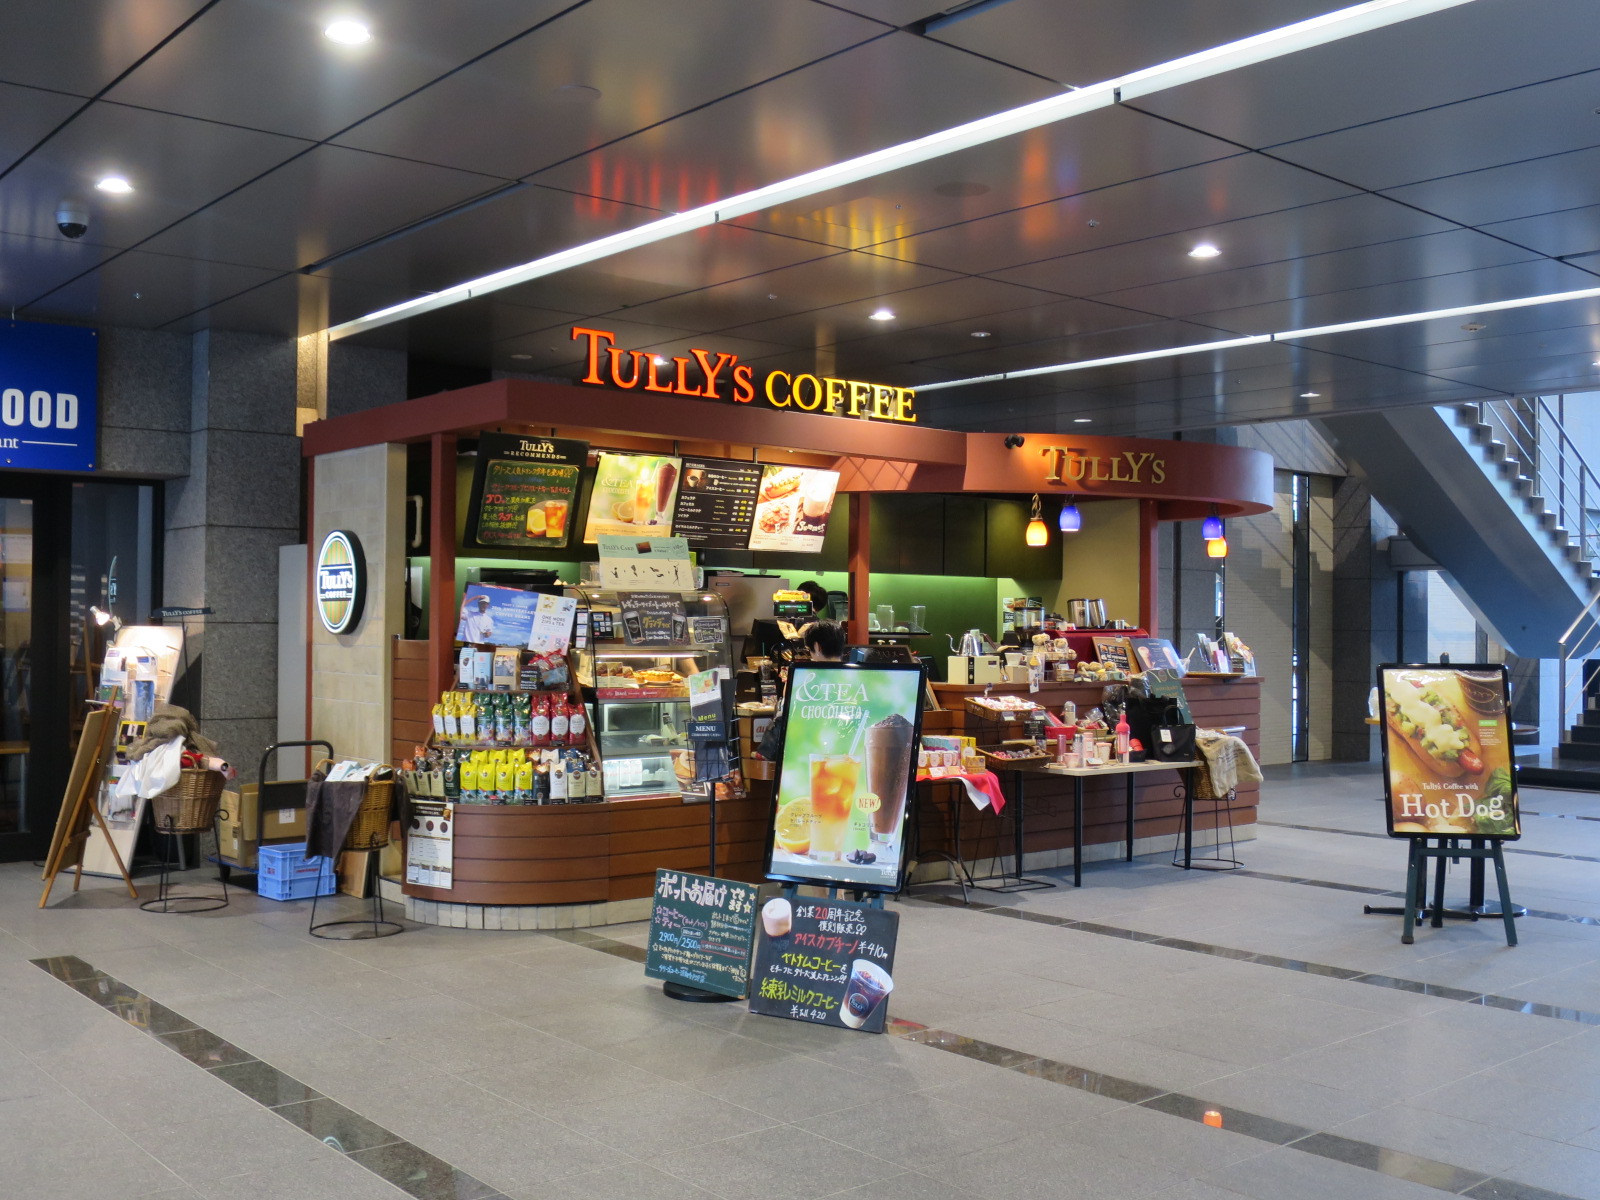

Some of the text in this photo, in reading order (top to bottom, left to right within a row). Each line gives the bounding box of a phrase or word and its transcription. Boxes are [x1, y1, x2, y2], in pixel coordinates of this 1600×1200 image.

[572, 327, 917, 422] TULLY'S COFFEE
[2, 388, 78, 429] OOD
[511, 451, 560, 459] RECOMMENDS
[520, 440, 555, 453] TULLY'S
[1039, 446, 1166, 484] TULLY'S
[320, 570, 353, 589] TULLY'S
[796, 672, 869, 702] &TEA
[697, 713, 716, 721] Menu
[1422, 782, 1441, 790] Tully's
[1464, 783, 1479, 791] with
[859, 797, 880, 808] NEW!
[1399, 793, 1506, 821] Hot Dog
[658, 872, 728, 908] ポットお届け
[796, 905, 865, 923] 創業20周年記念
[758, 977, 840, 1010] 練乳ミルクコーヒー
